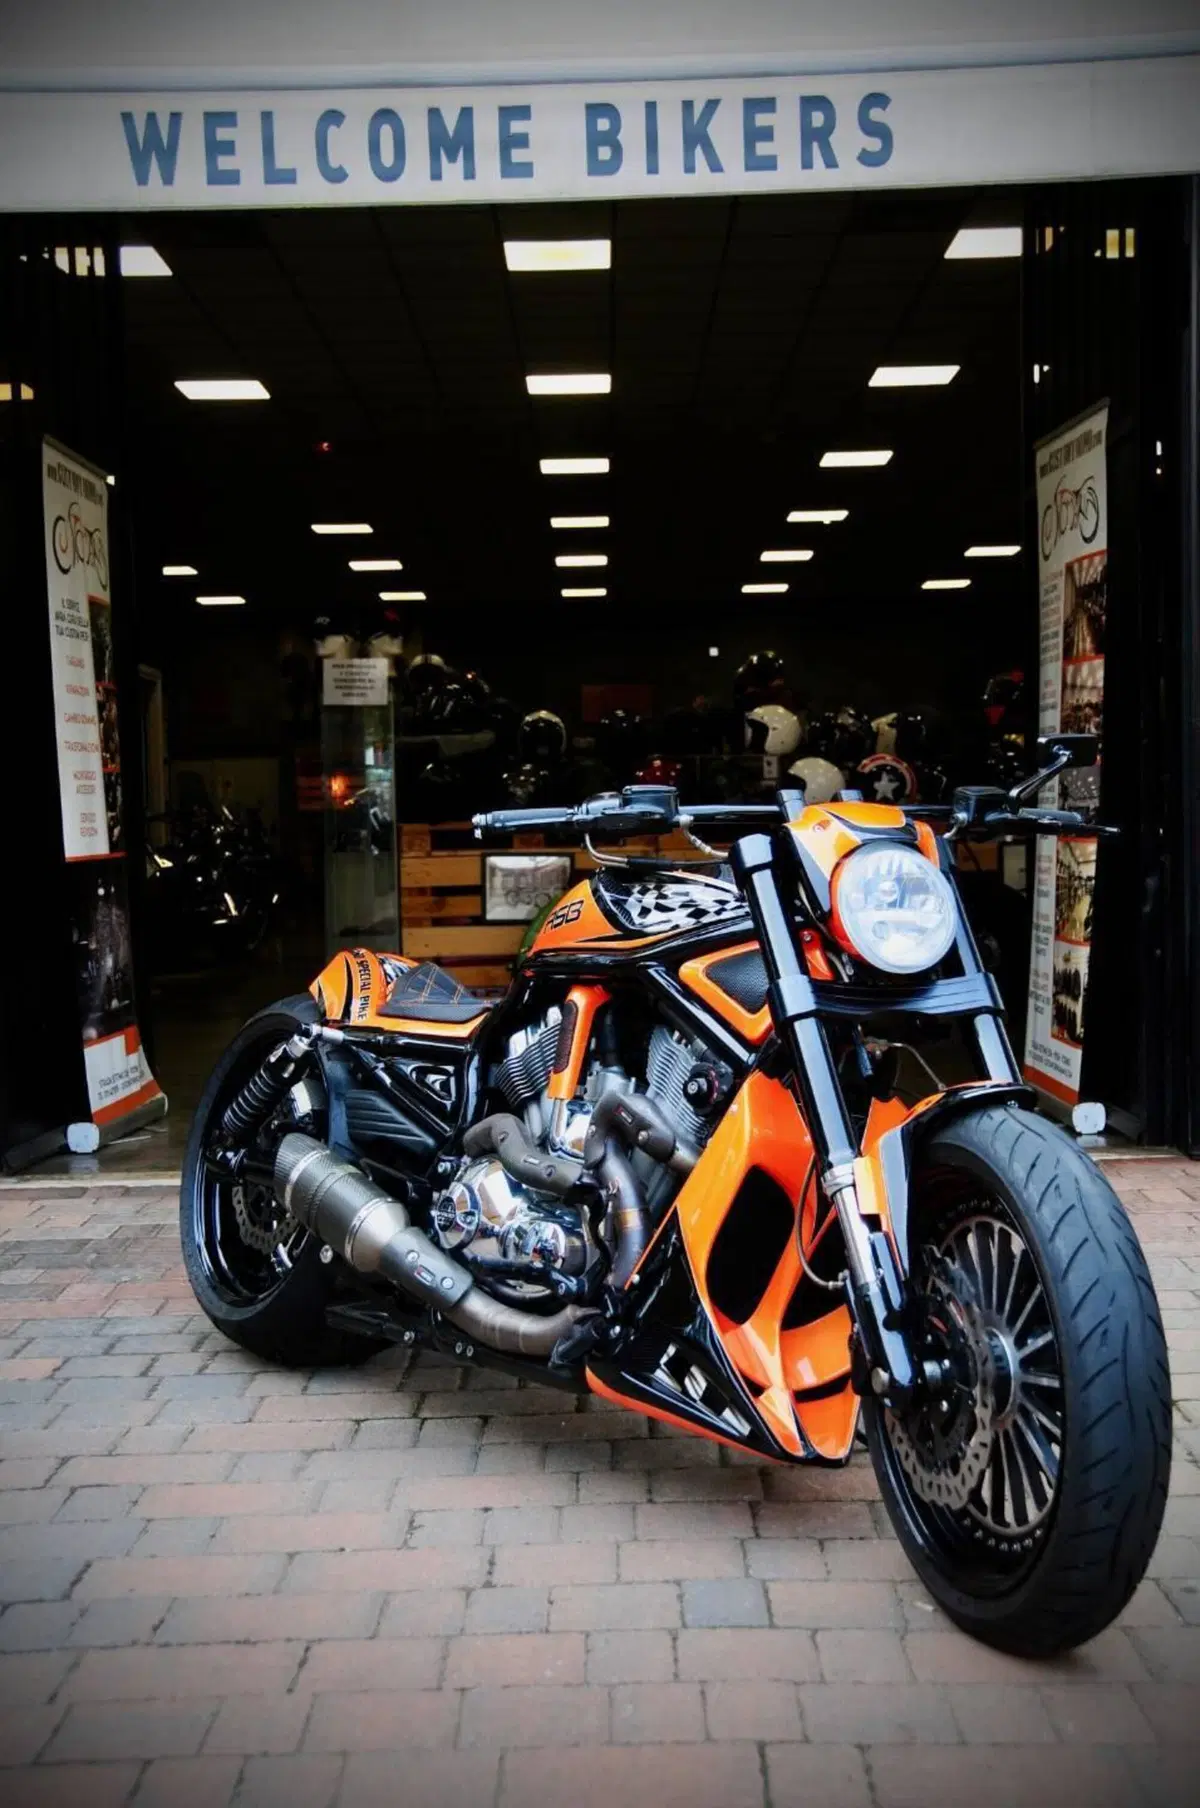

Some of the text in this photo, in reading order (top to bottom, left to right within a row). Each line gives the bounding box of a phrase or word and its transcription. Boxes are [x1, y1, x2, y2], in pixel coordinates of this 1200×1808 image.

[120, 92, 894, 186] WELCOME BIKERS
[357, 960, 371, 993] SPECIAL
[357, 995, 371, 1020] BIKE
